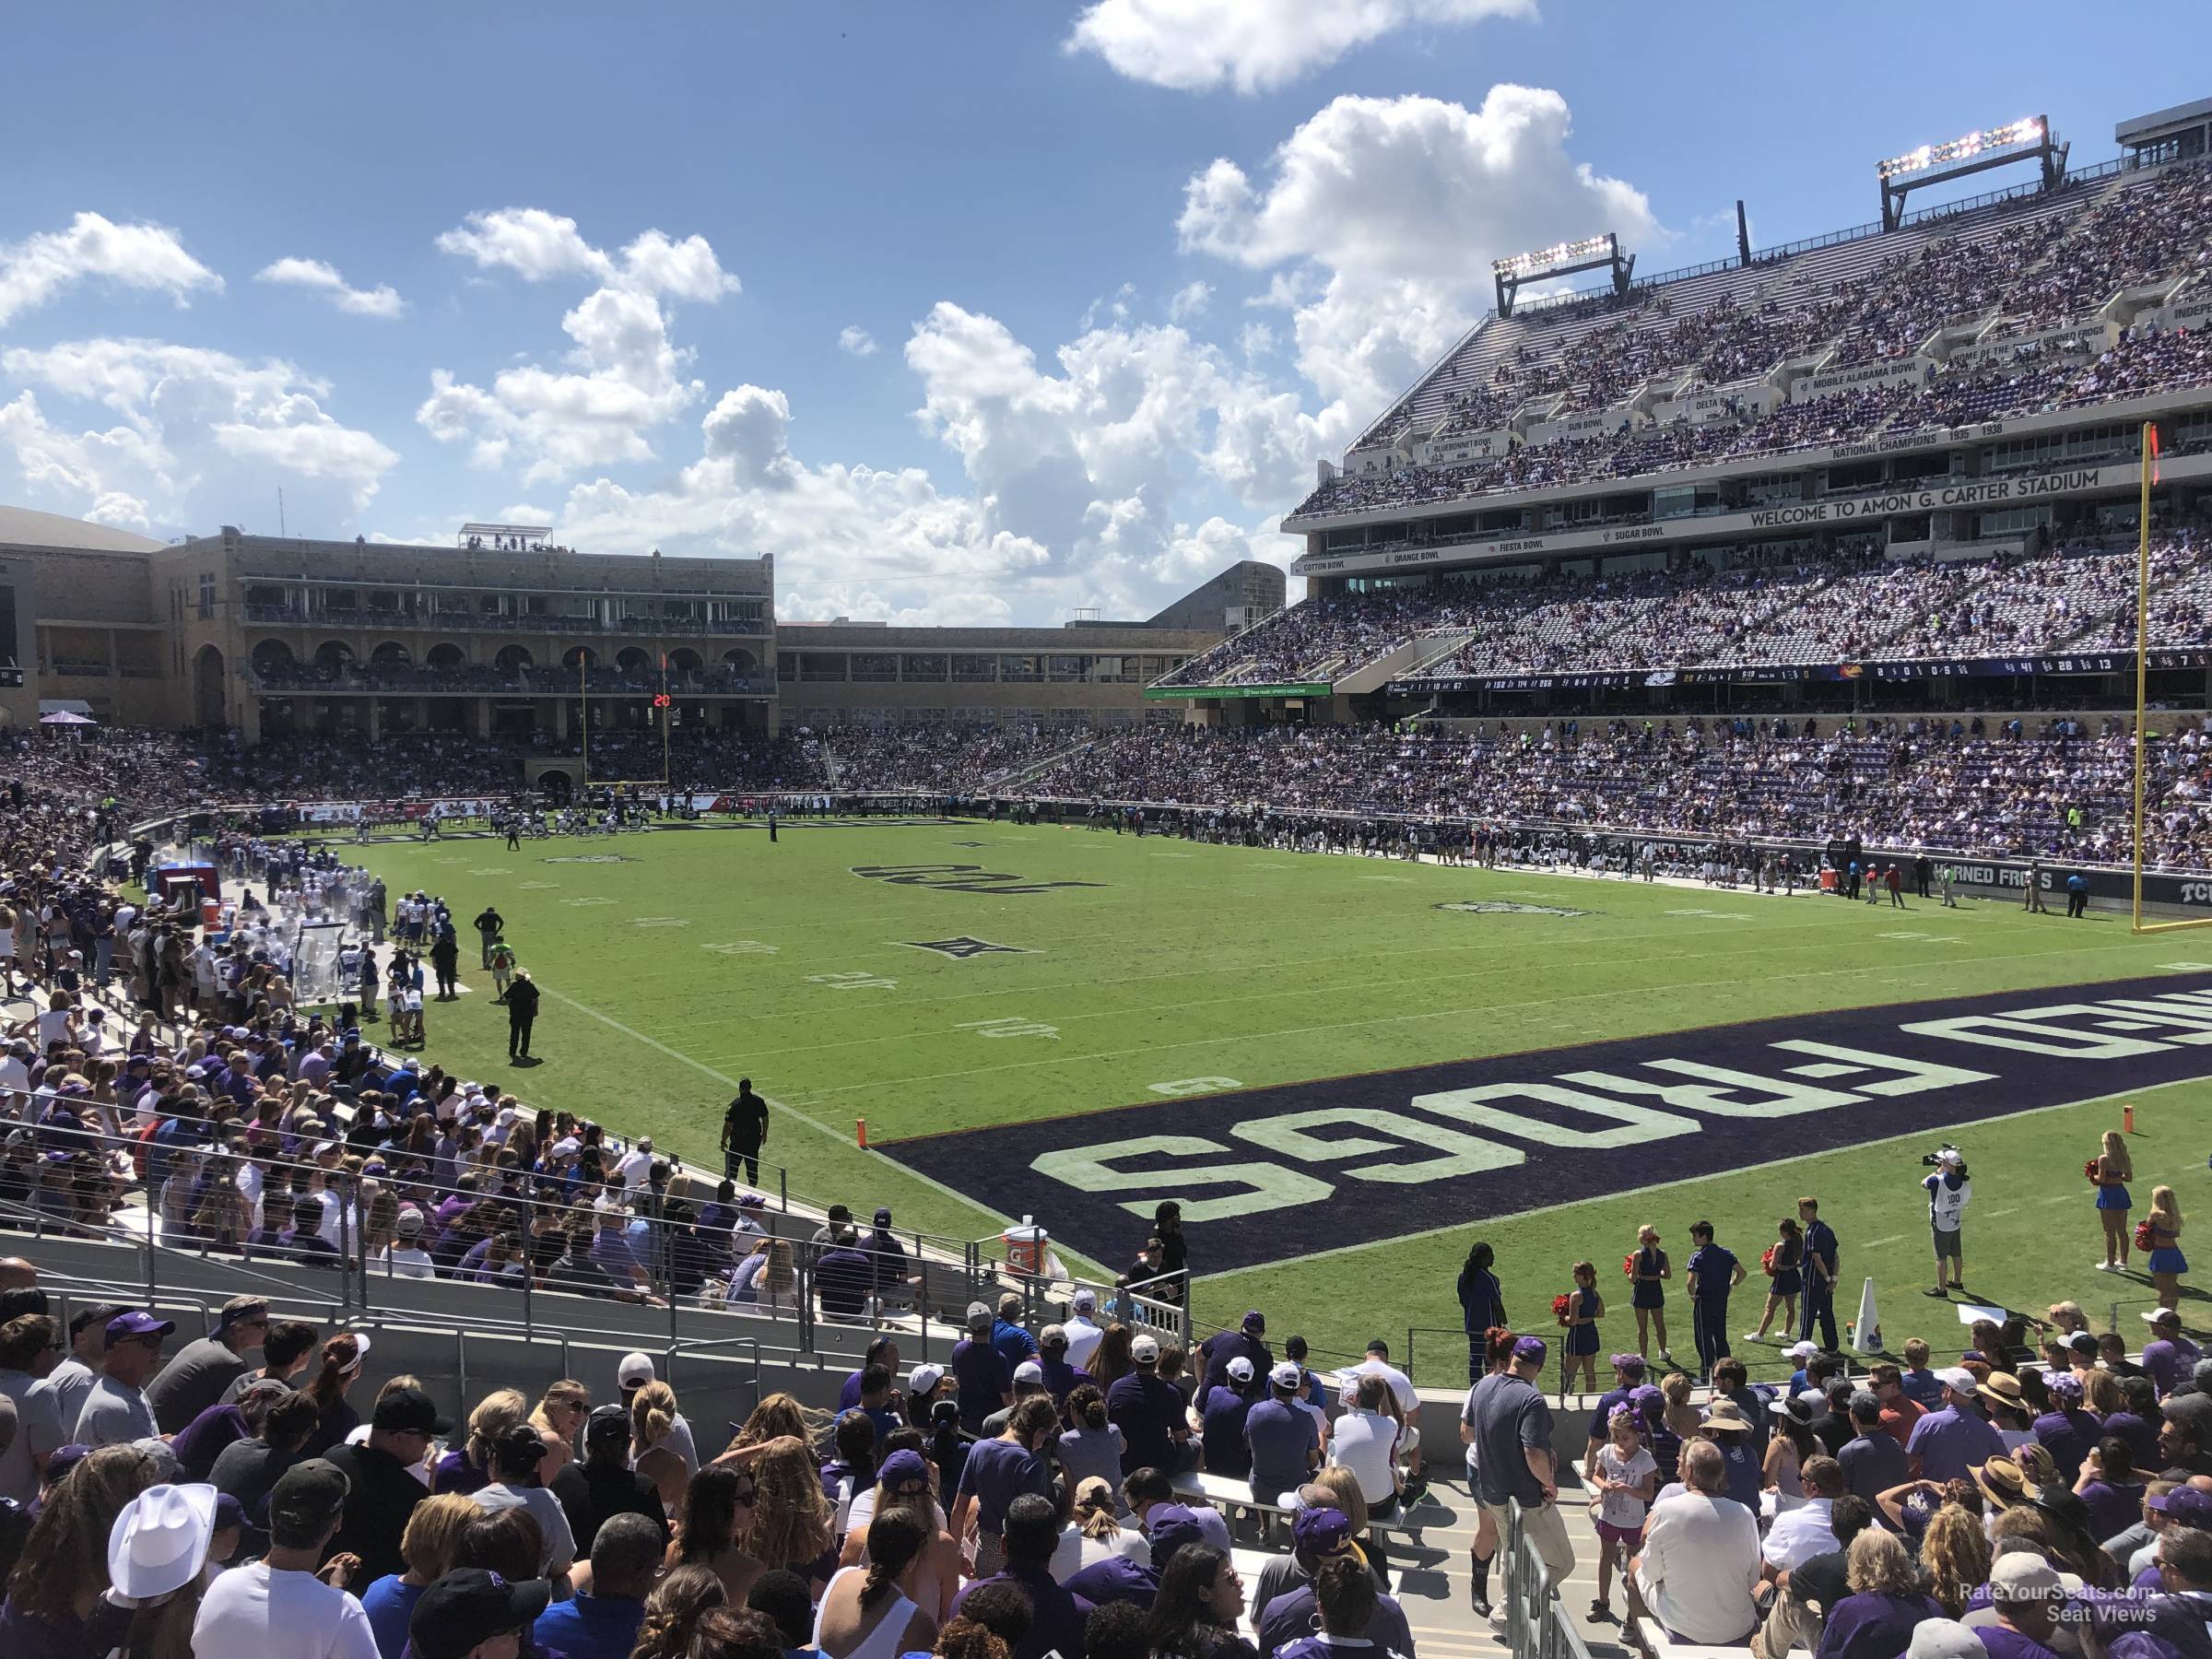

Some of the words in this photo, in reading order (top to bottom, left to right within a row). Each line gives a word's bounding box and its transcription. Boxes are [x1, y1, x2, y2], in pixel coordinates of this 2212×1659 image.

[2043, 333, 2076, 346] HORNED
[2077, 325, 2104, 338] FROGS
[1954, 350, 1978, 362] HOME
[1980, 347, 1991, 359] OF
[1993, 345, 2010, 356] THE
[1813, 375, 1844, 389] MOBILE
[1846, 369, 1889, 383] ALABAMA
[1891, 361, 1917, 375] BOWL
[1696, 398, 1717, 410] DELTA
[1568, 421, 1582, 431] SUN
[1583, 418, 1604, 429] BOWL
[1982, 424, 2003, 436] 1938
[1948, 429, 1970, 441] 1935
[1433, 439, 1474, 453] BLUEBONNET
[1475, 437, 1491, 448] BOWL
[1832, 444, 1877, 459] NATIONAL
[1879, 434, 1936, 452] CHAMPIONS
[1751, 507, 1827, 527] WELCOME
[1833, 502, 1854, 518] TO
[1861, 495, 1912, 514] AMON
[1919, 493, 1935, 507] G.
[1942, 483, 2008, 504] CARTER
[2018, 470, 2100, 495] STADIUM
[1615, 529, 1641, 540] SUGAR
[1641, 526, 1664, 537] BOWL
[1500, 542, 1522, 552] FIESTA
[1524, 539, 1543, 550] BOWL
[1394, 552, 1419, 563] ORANGE
[1420, 550, 1440, 560] BOWL
[1303, 561, 1326, 571] COTTON
[1327, 560, 1344, 570] BOWL
[654, 693, 670, 707] 20
[1999, 868, 2052, 889] FROS
[1947, 1194, 1961, 1205] 100
